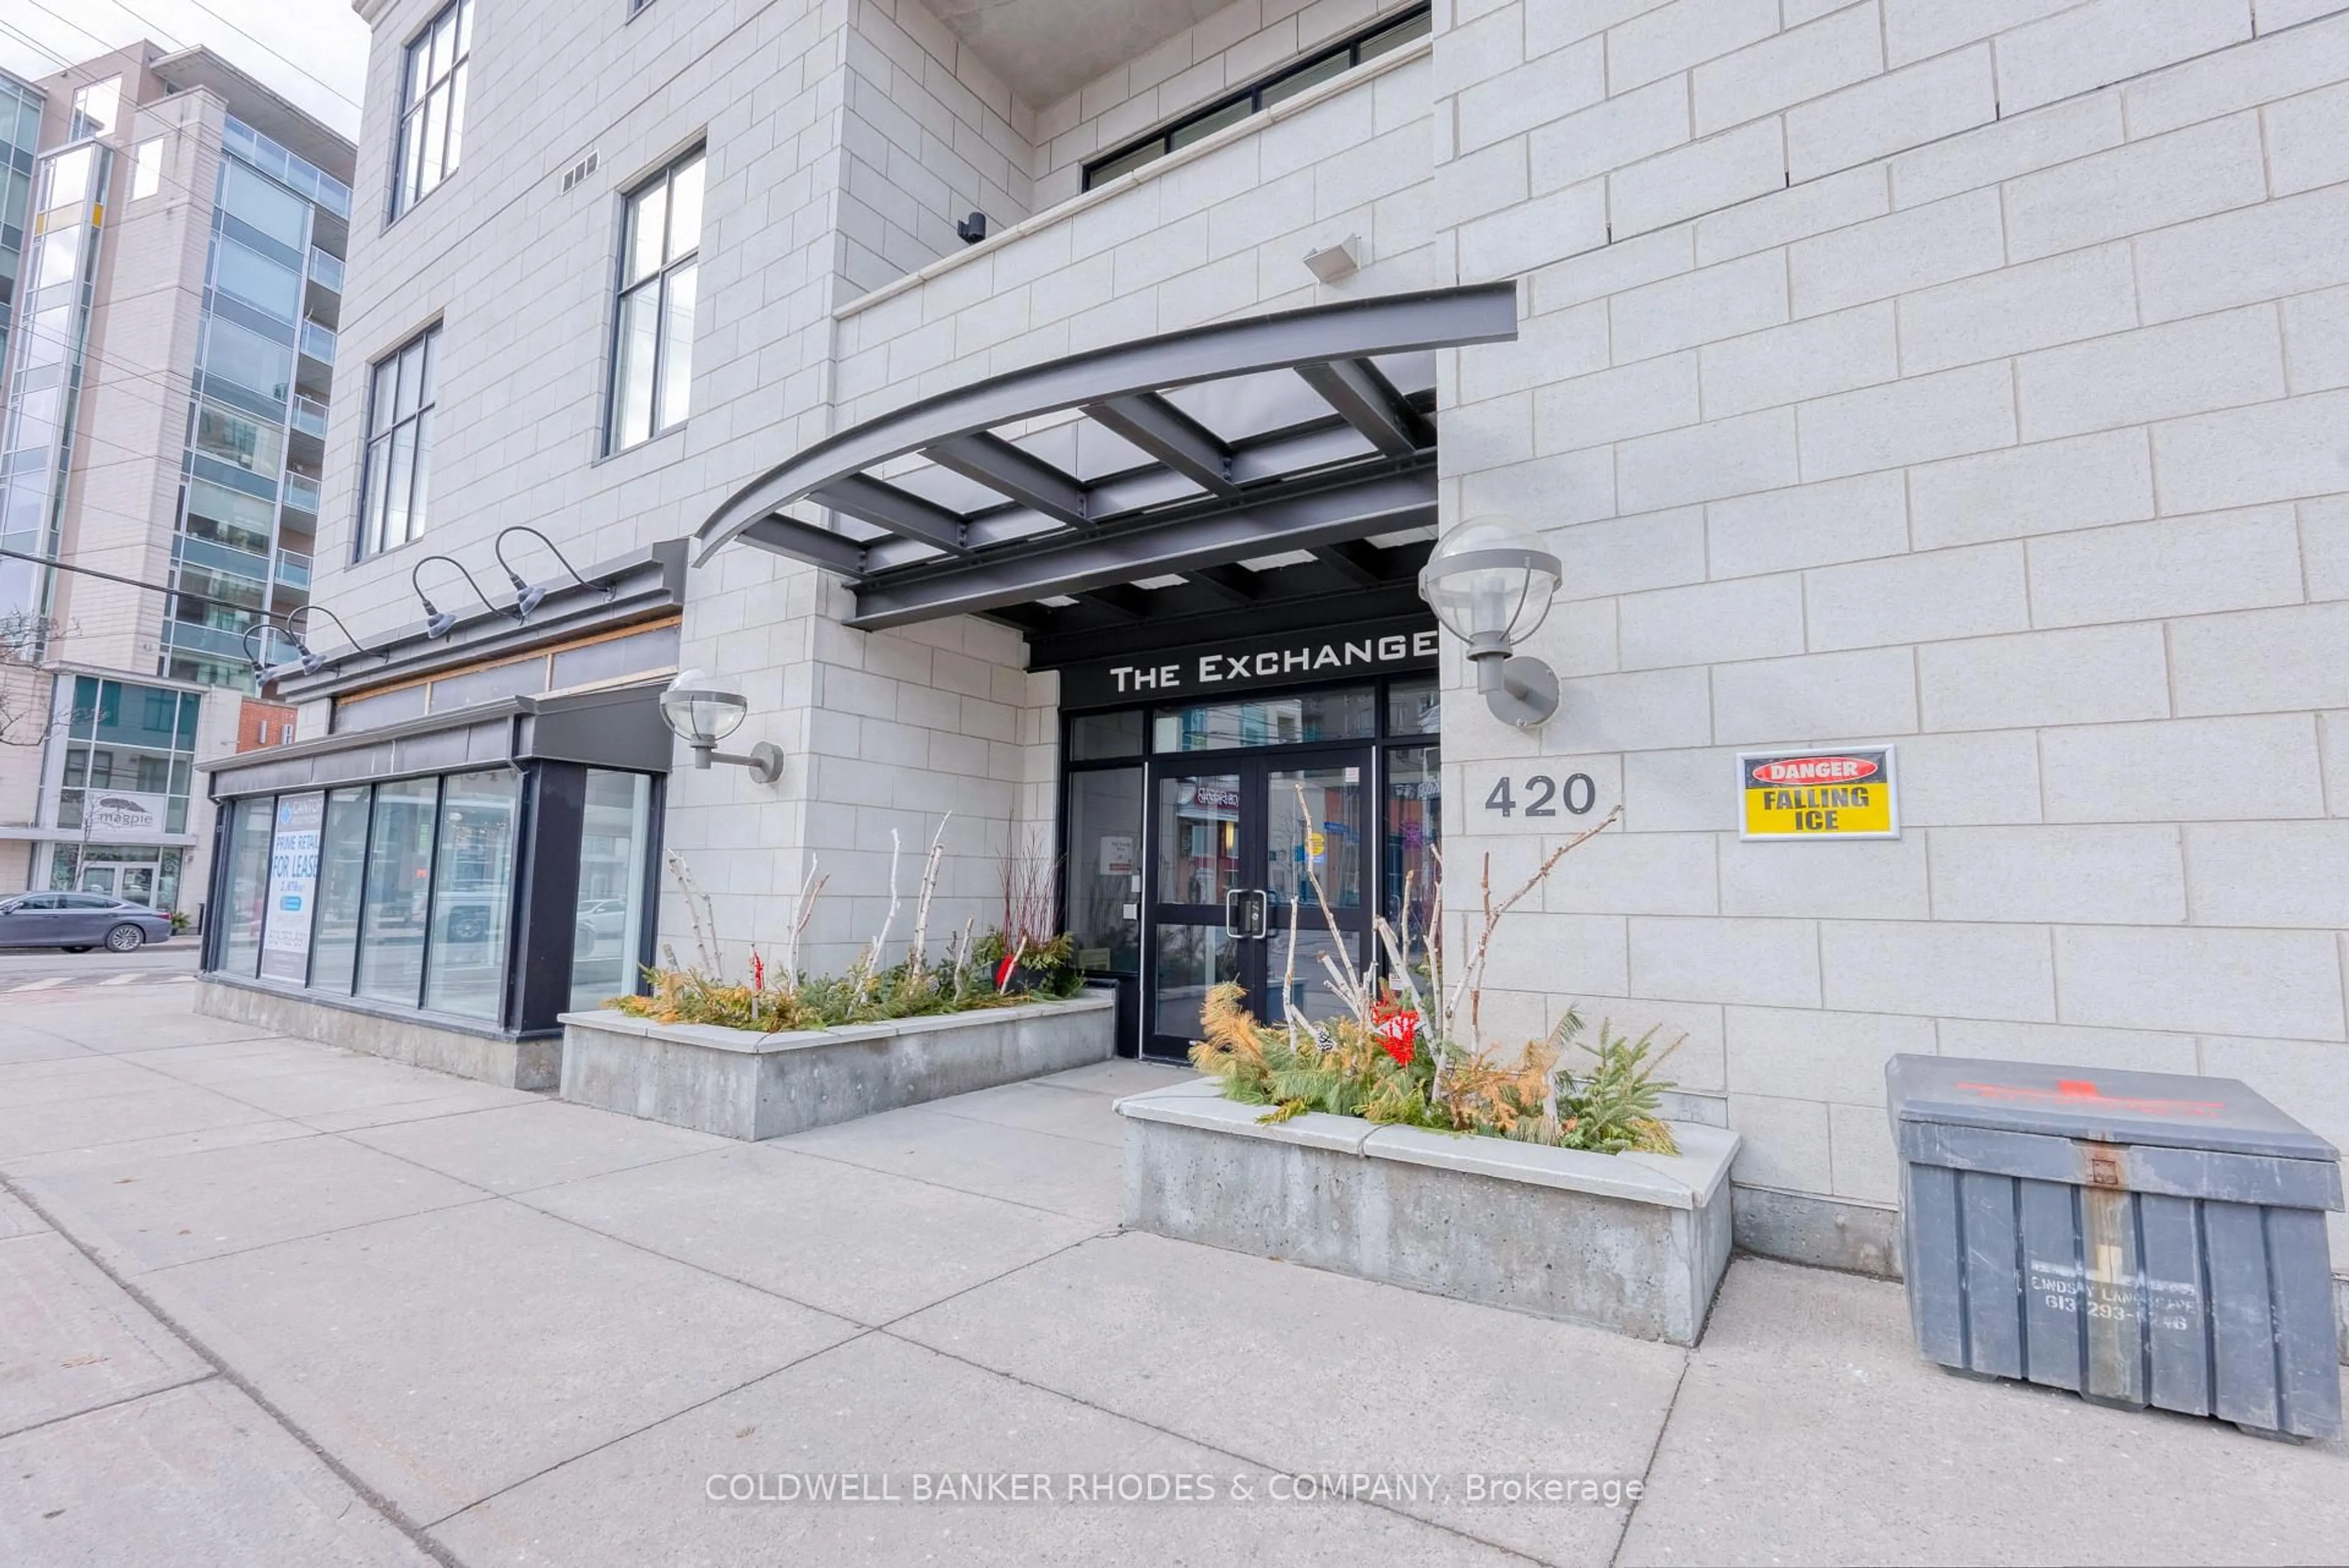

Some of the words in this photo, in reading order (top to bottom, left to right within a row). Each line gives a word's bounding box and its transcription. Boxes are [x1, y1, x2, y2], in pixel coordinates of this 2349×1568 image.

[1110, 665, 1180, 692] THE
[1199, 631, 1438, 682] EXCHANGE
[1771, 761, 1858, 780] DANGER
[1485, 772, 1596, 818] 420
[1764, 786, 1869, 810] FALLING
[100, 813, 152, 827] magpie
[1795, 810, 1839, 830] ICE
[276, 835, 296, 851] PRIME
[273, 856, 289, 878] FOR
